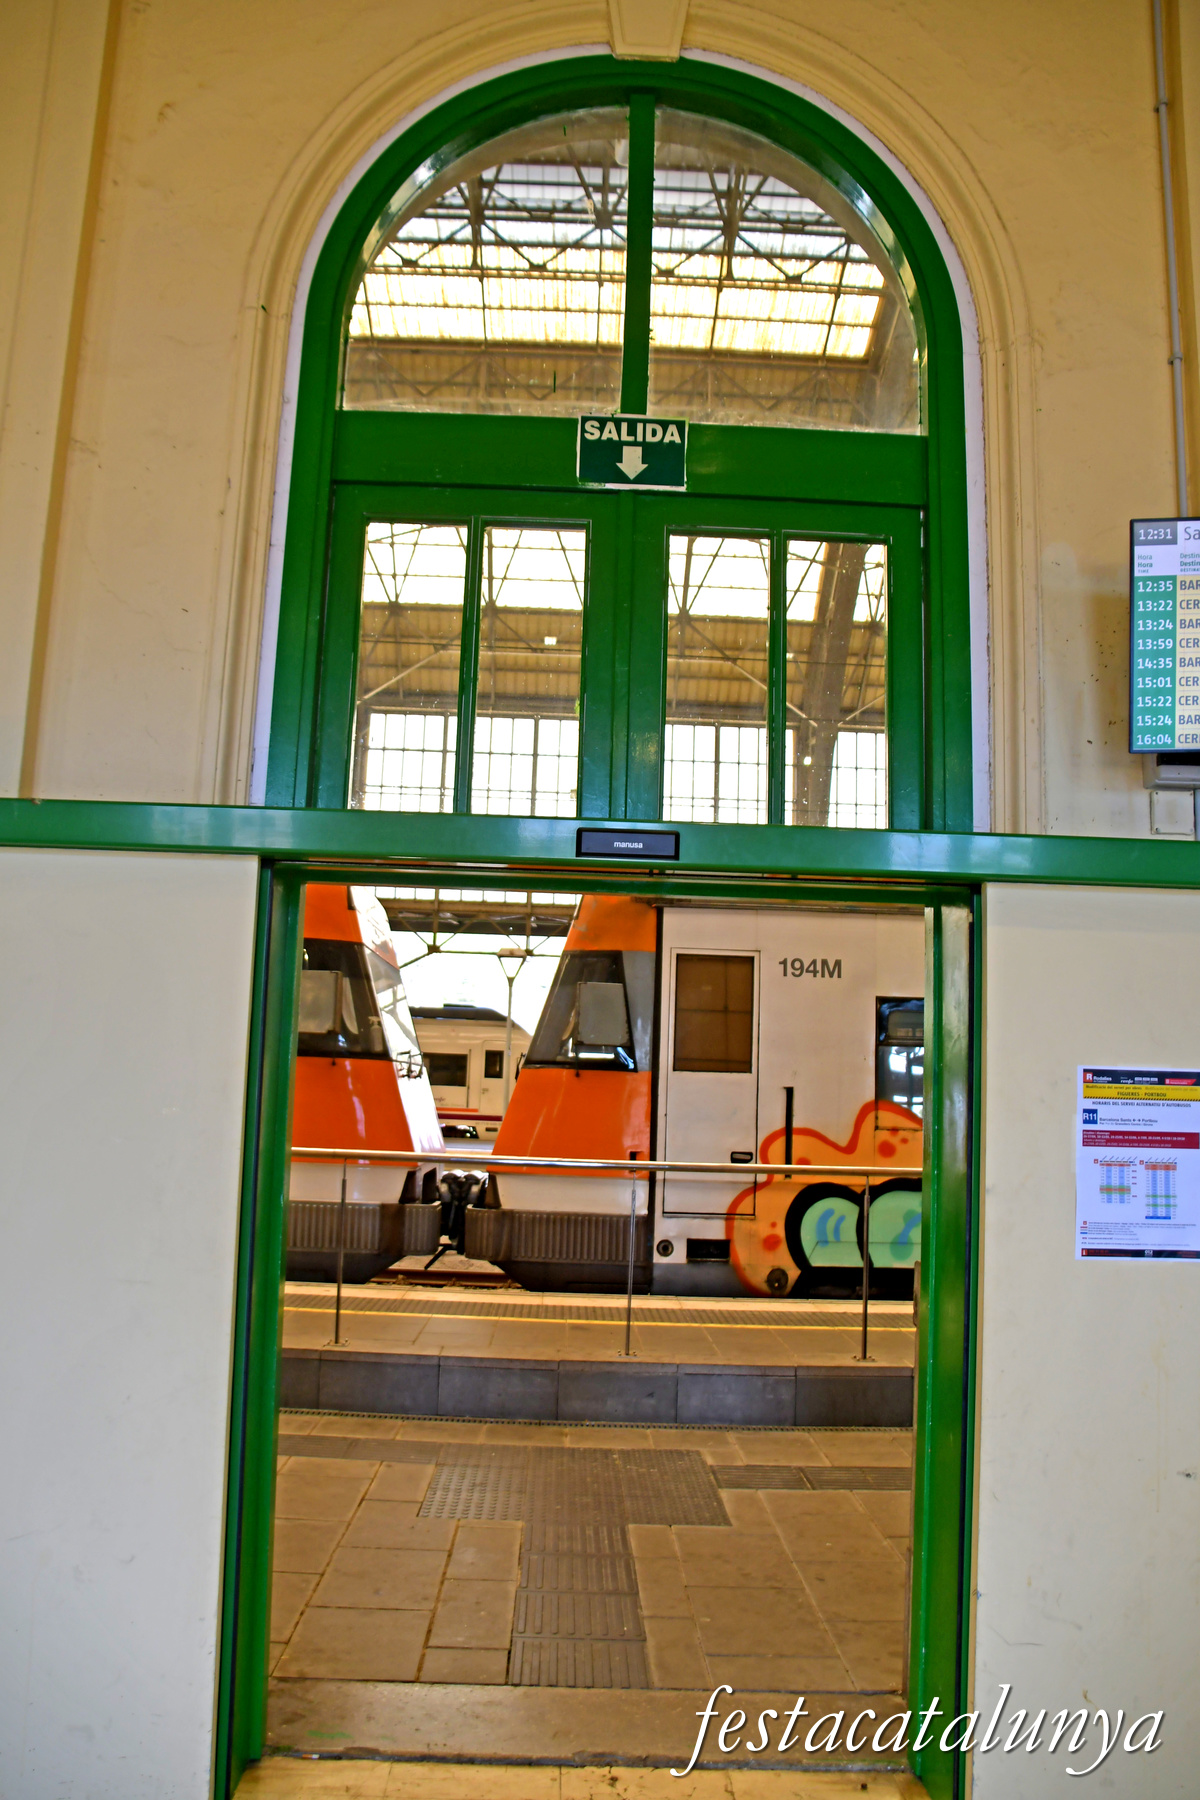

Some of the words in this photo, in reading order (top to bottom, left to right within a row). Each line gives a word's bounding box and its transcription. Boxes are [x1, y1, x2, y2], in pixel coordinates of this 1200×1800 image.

[584, 420, 682, 443] SALIDA
[1139, 528, 1173, 540] 12:31
[1138, 580, 1173, 592] 12:35
[1137, 600, 1173, 611] 13:22
[1138, 619, 1173, 631] 13:24
[1137, 638, 1173, 650] 13:59
[1137, 657, 1173, 669] 14:35
[1137, 676, 1172, 688] 15:01
[1137, 696, 1172, 707] 15:22
[1136, 714, 1172, 726] 15:24
[1136, 733, 1172, 745] 16:04
[1177, 733, 1200, 744] CER
[614, 841, 643, 849] manusa
[779, 957, 842, 979] 194M
